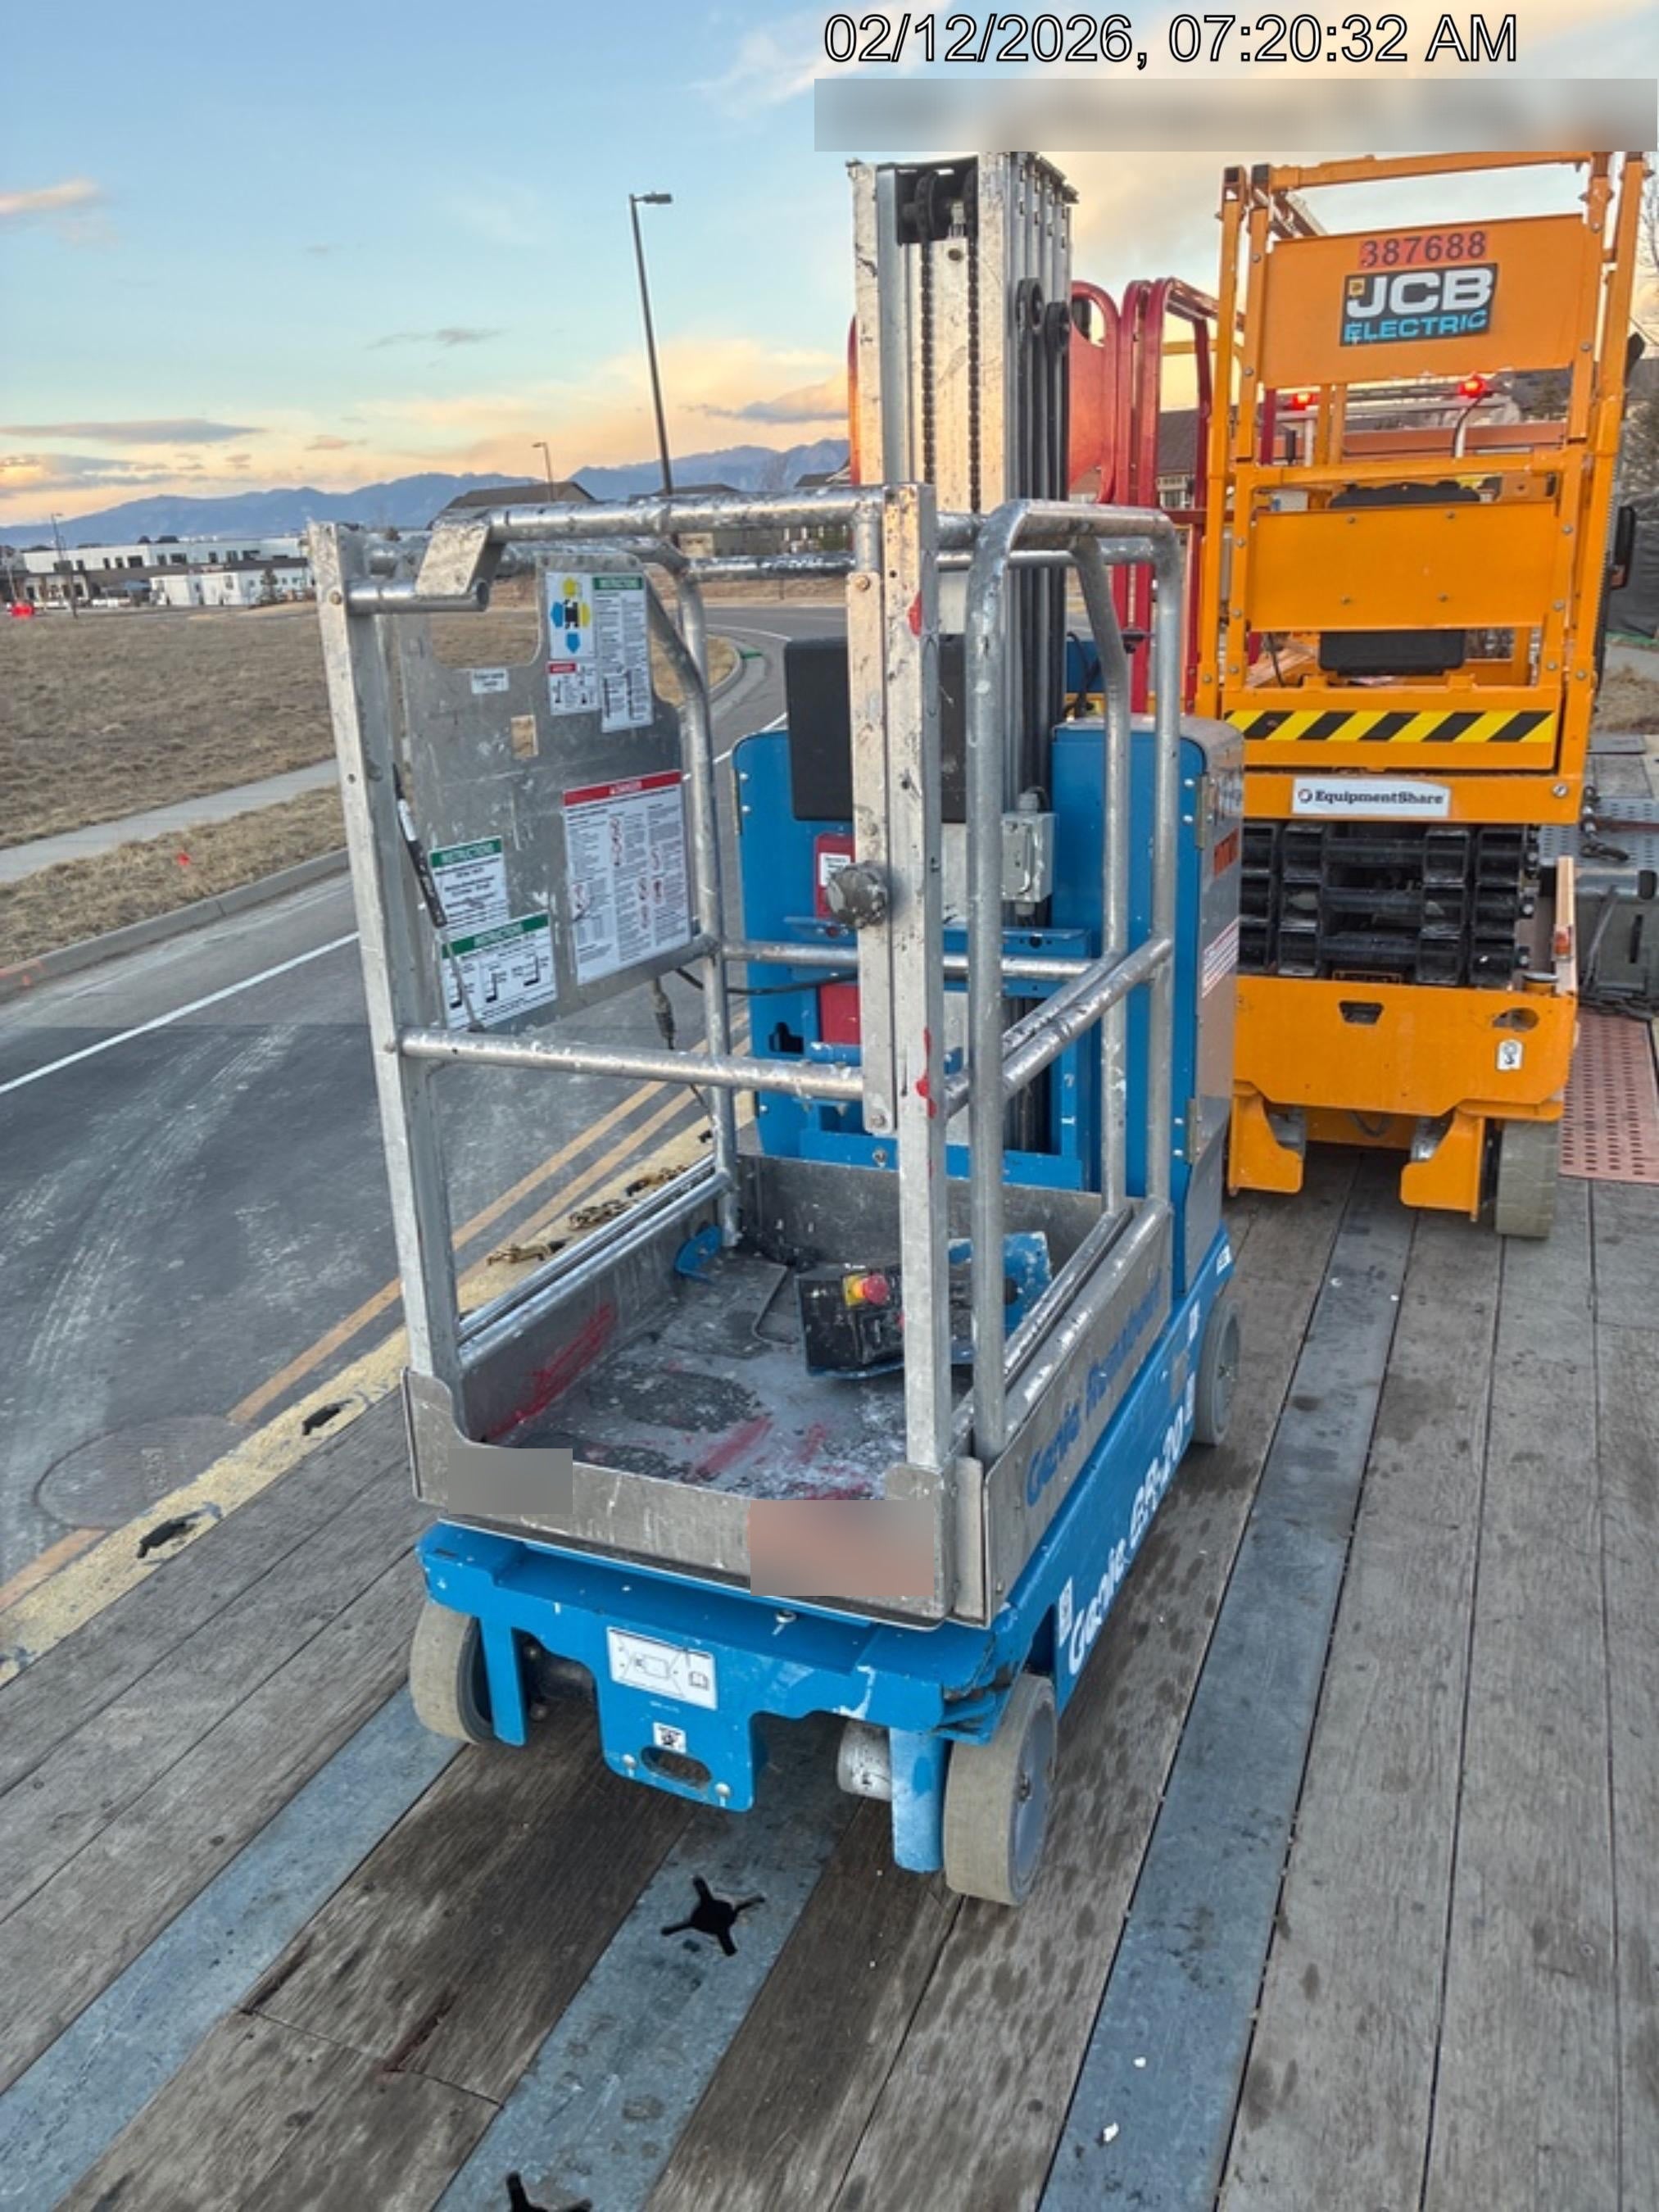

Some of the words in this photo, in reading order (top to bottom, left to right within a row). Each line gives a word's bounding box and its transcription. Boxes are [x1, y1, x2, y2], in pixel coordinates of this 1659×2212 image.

[1361, 230, 1486, 269] 387688
[1346, 267, 1494, 319] JCB
[1344, 309, 1487, 343] ELECTRIC
[1314, 790, 1444, 805] EquipmentShare
[1068, 1537, 1126, 1675] Genie
